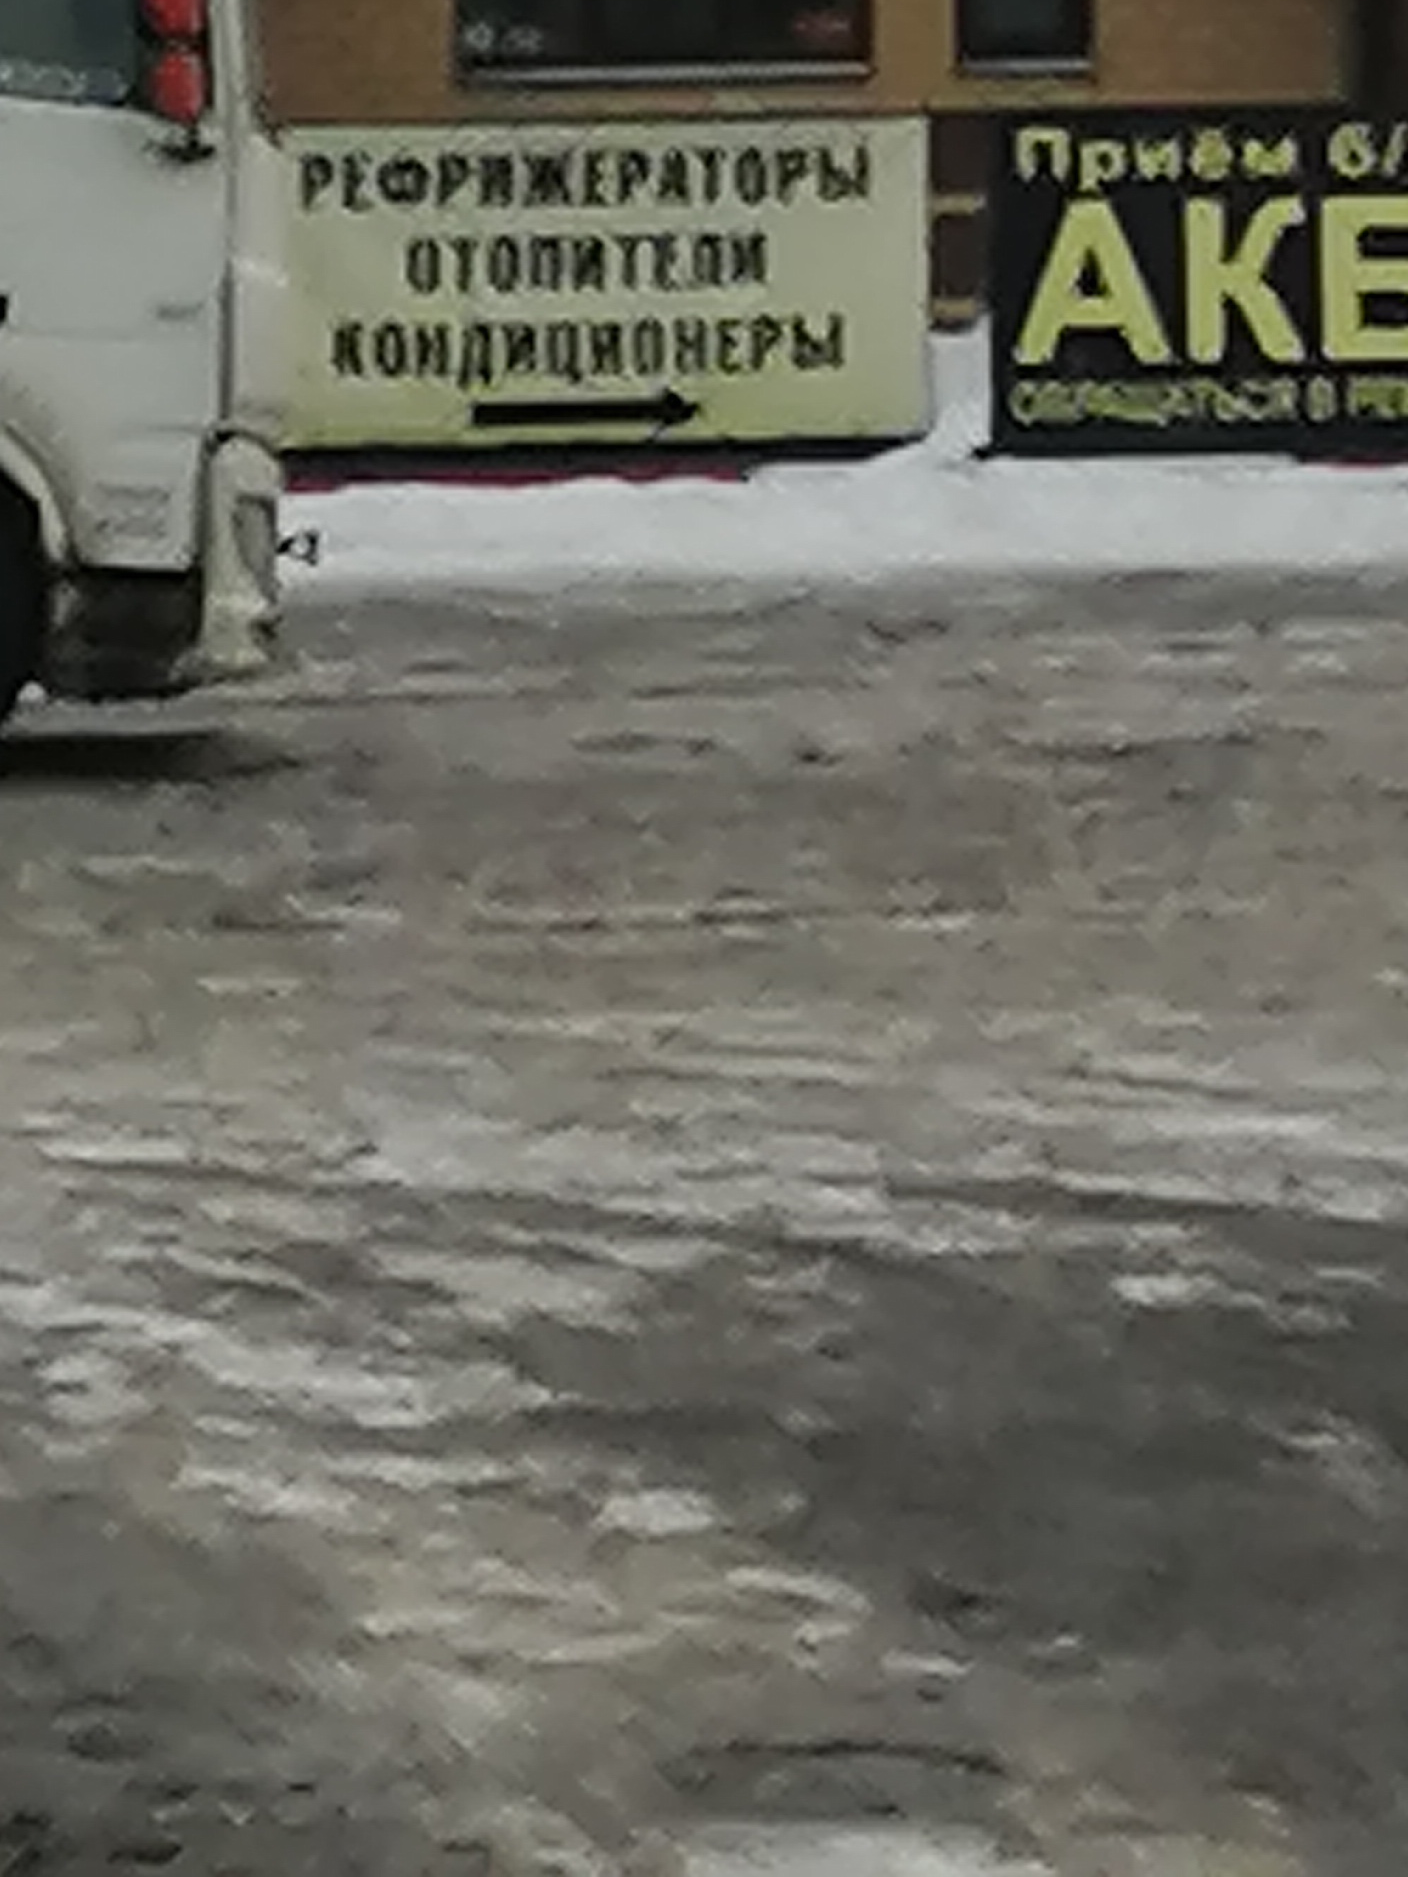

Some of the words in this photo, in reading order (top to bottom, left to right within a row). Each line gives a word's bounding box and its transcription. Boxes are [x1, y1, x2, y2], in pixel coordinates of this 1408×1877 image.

[296, 145, 872, 213] РЕФРИЖЕРАТОРЫ
[404, 232, 768, 294] ОТОПИТЕЛИ
[330, 312, 845, 387] КОНДИЦИОНЕРЫ
